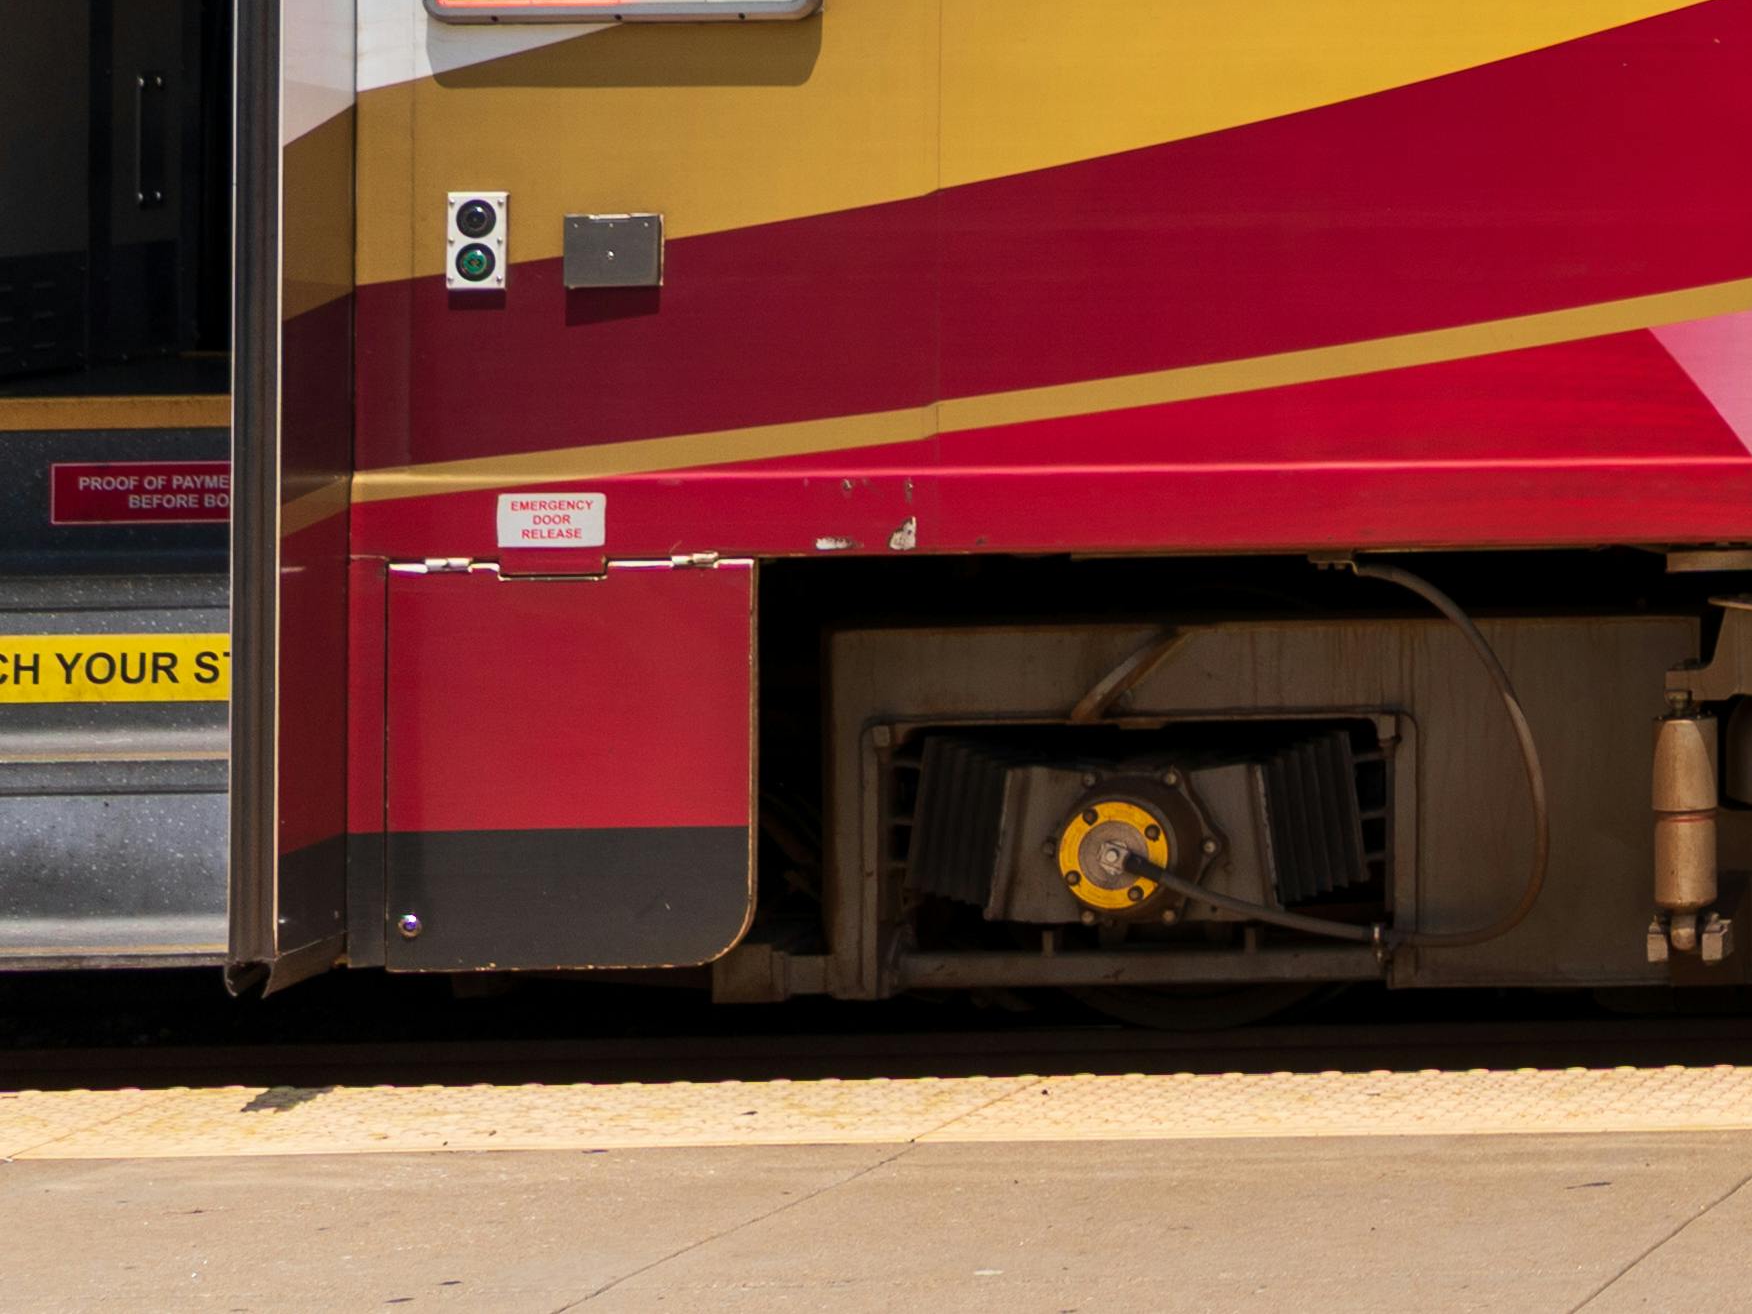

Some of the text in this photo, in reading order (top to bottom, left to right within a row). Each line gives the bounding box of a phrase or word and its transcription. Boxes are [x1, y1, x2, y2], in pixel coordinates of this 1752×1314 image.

[79, 475, 231, 491] PROOF OF PAYME
[128, 494, 200, 509] BEFORE
[511, 500, 594, 511] EMERGENCY
[533, 514, 572, 525] DOOR
[521, 528, 582, 539] RELEASE
[55, 651, 180, 685] YOUR
